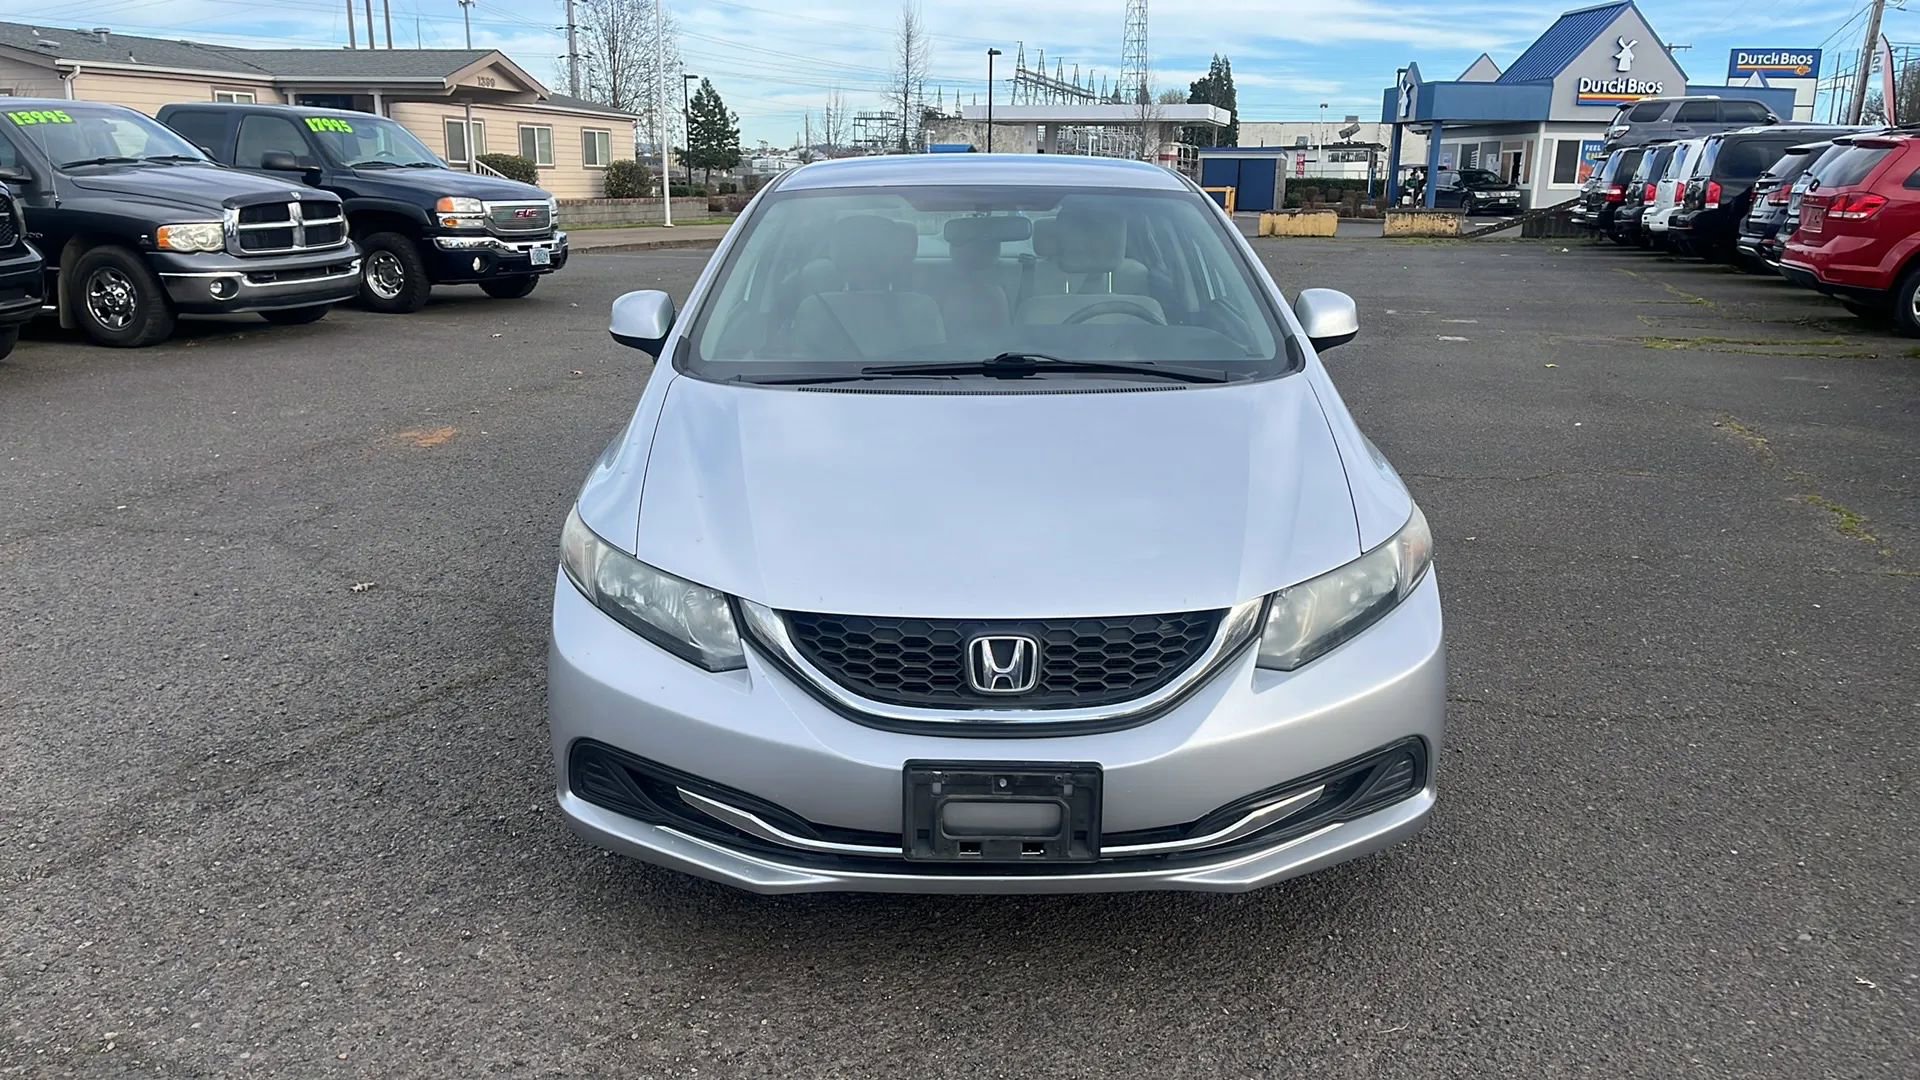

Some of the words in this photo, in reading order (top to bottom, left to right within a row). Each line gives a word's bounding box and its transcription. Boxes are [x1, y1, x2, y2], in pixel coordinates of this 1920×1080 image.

[1780, 52, 1813, 65] BROS
[1627, 78, 1663, 94] BROS
[7, 110, 74, 126] 13995
[304, 117, 353, 134] 17995
